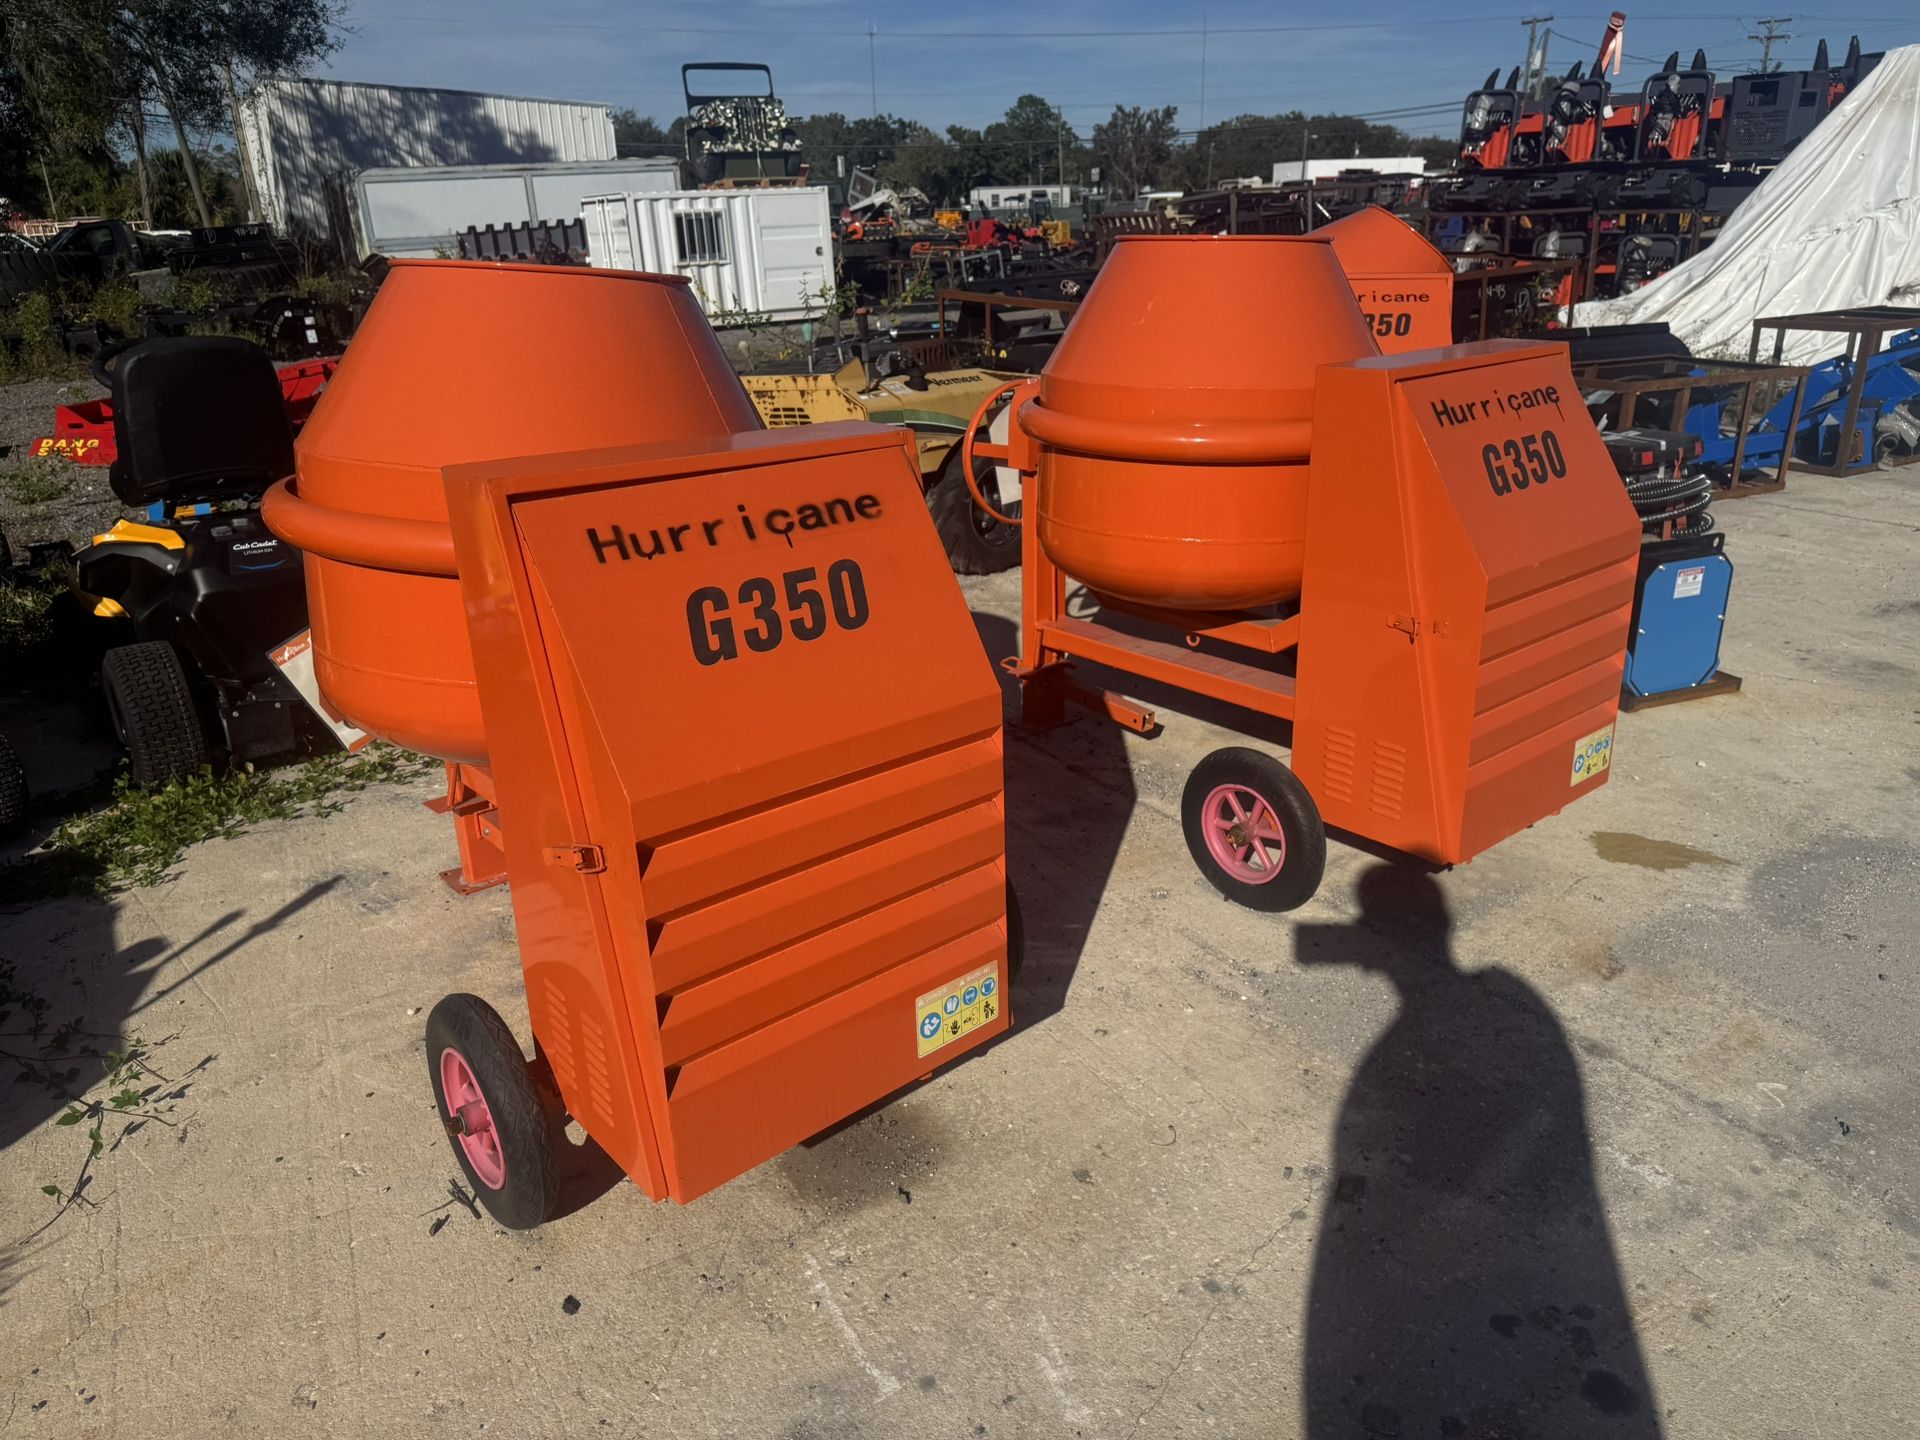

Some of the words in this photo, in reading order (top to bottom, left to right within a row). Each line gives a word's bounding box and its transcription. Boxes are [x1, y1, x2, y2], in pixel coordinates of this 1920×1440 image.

[927, 375, 982, 386] Vermeer
[1430, 386, 1560, 427] Hurricane
[1482, 430, 1567, 496] G350
[232, 543, 251, 551] Cub
[250, 539, 278, 548] Cadet
[586, 493, 883, 565] Hurricane
[685, 558, 870, 667] G350
